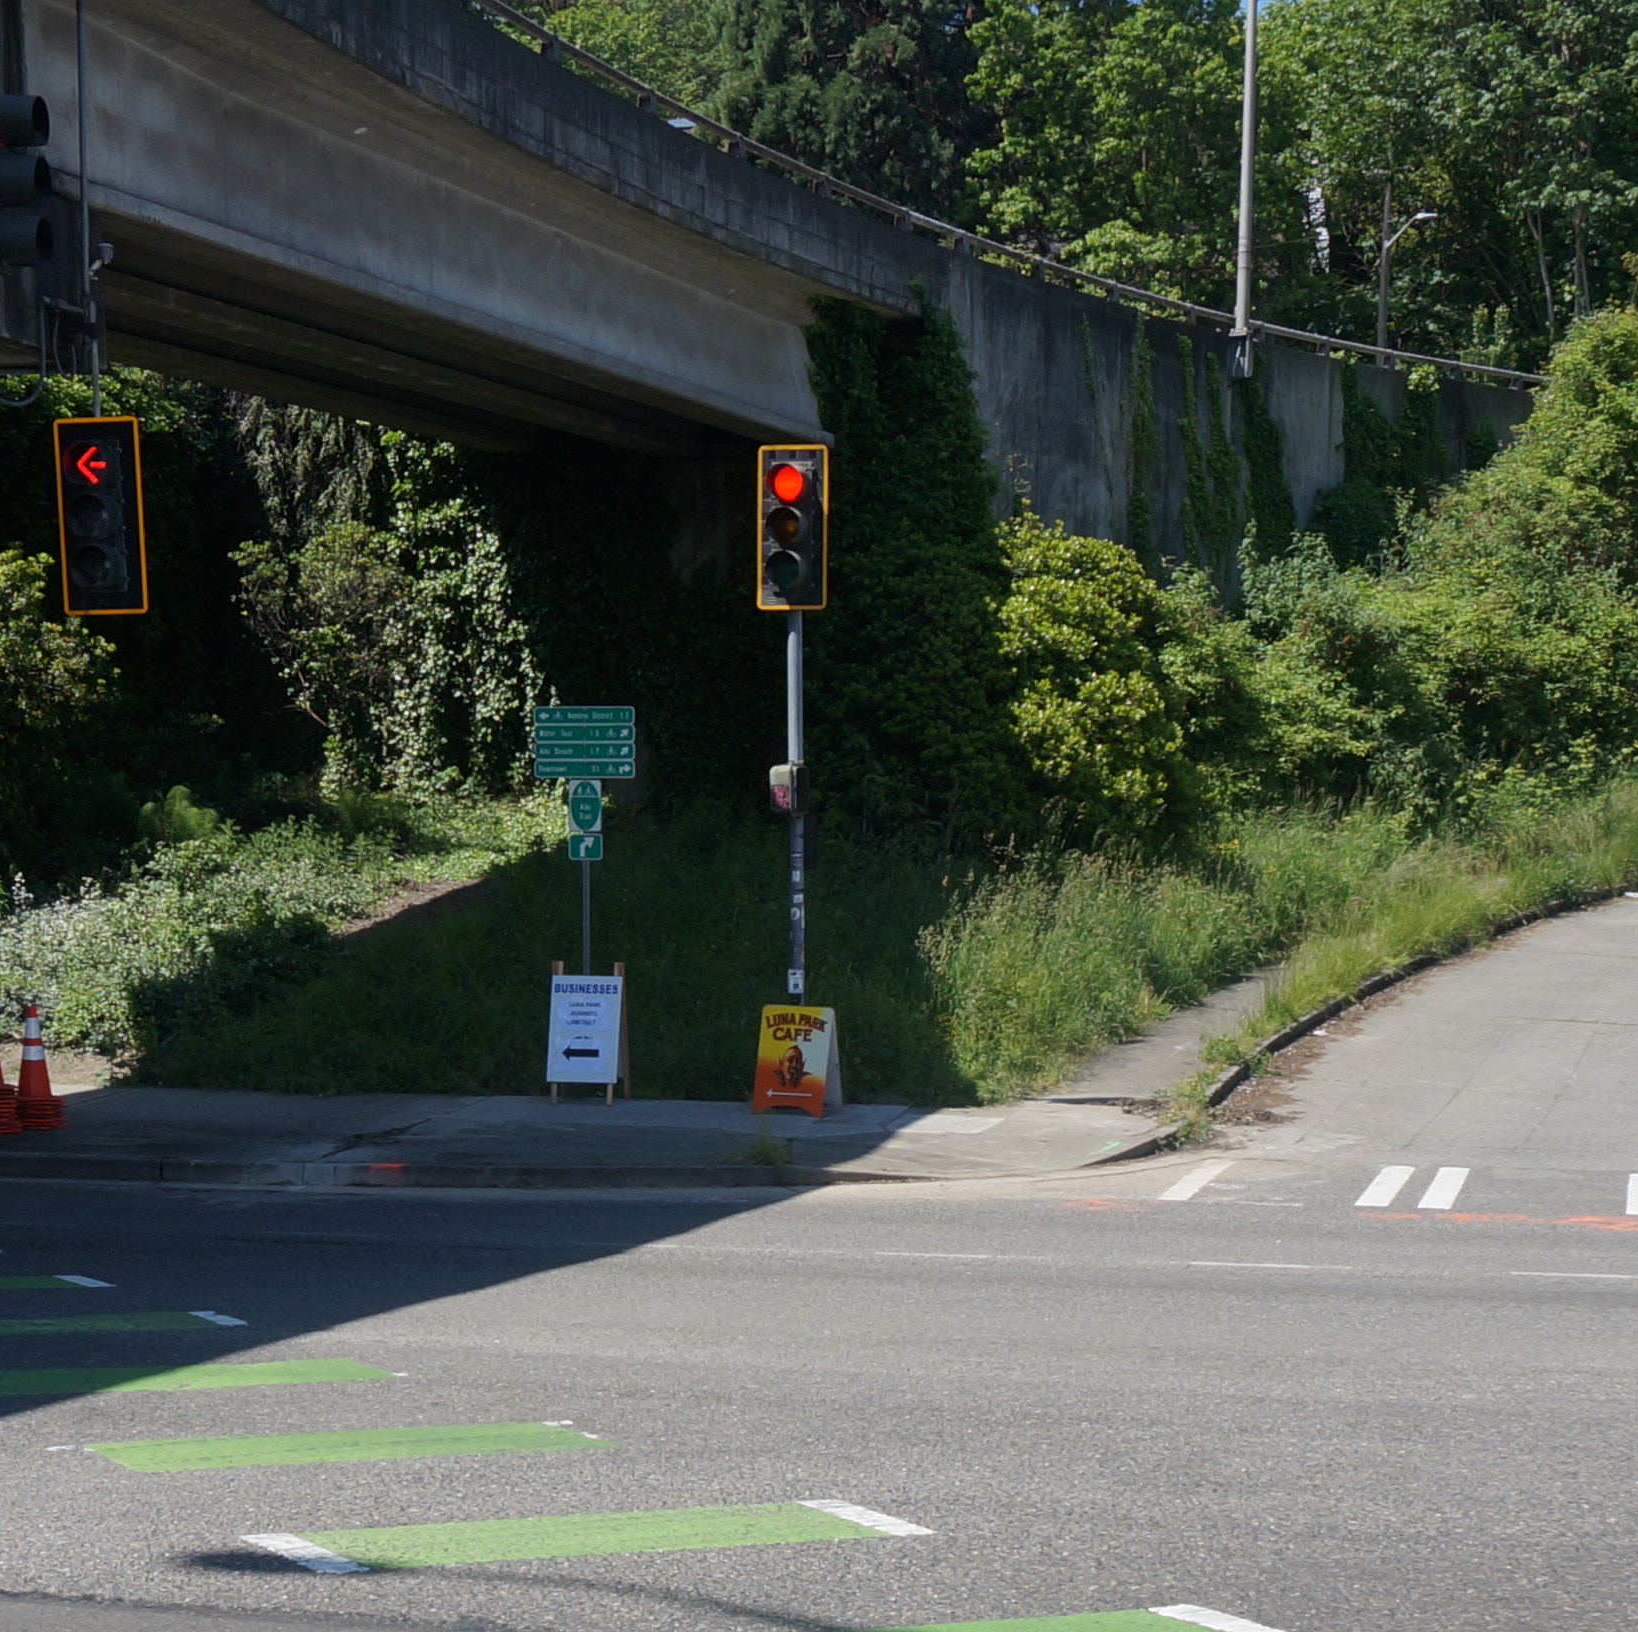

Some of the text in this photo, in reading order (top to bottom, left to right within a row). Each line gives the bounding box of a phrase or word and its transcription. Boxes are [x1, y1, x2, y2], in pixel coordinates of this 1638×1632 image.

[554, 983, 618, 994] BUSINESSES
[765, 1013, 828, 1033] LUNA PARK
[773, 1027, 813, 1042] CAFE
